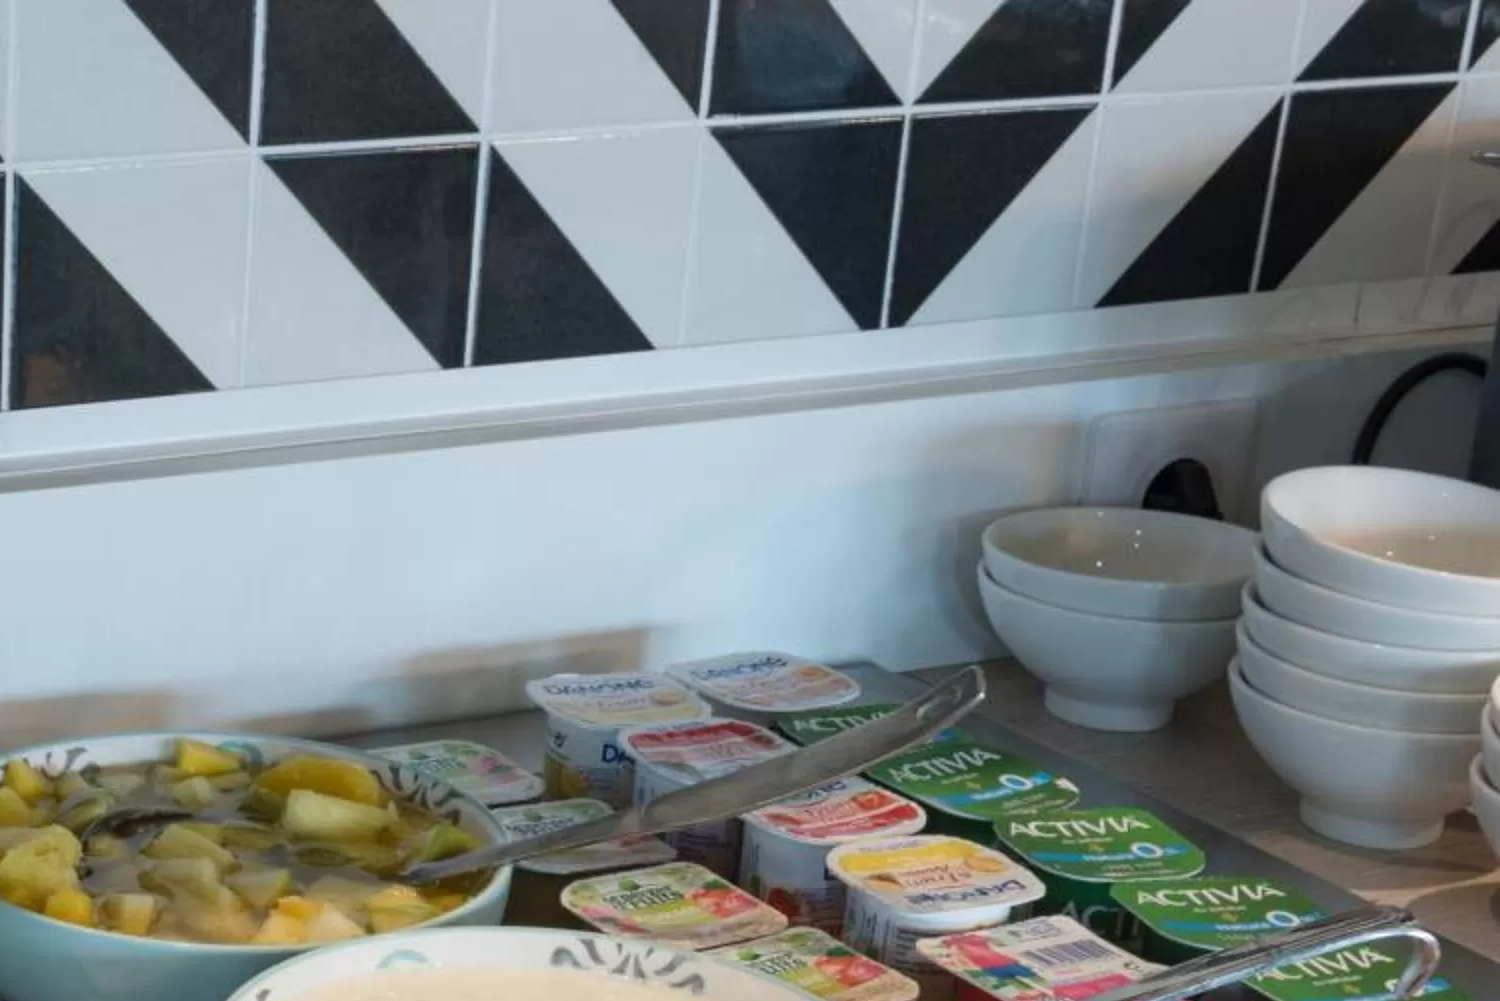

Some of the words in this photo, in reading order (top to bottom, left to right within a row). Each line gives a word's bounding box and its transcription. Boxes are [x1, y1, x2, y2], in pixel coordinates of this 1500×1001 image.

[887, 747, 1001, 783] ACTIVIA
[1010, 815, 1151, 838] ACTIVIA
[1136, 883, 1288, 907] ACTIVIA
